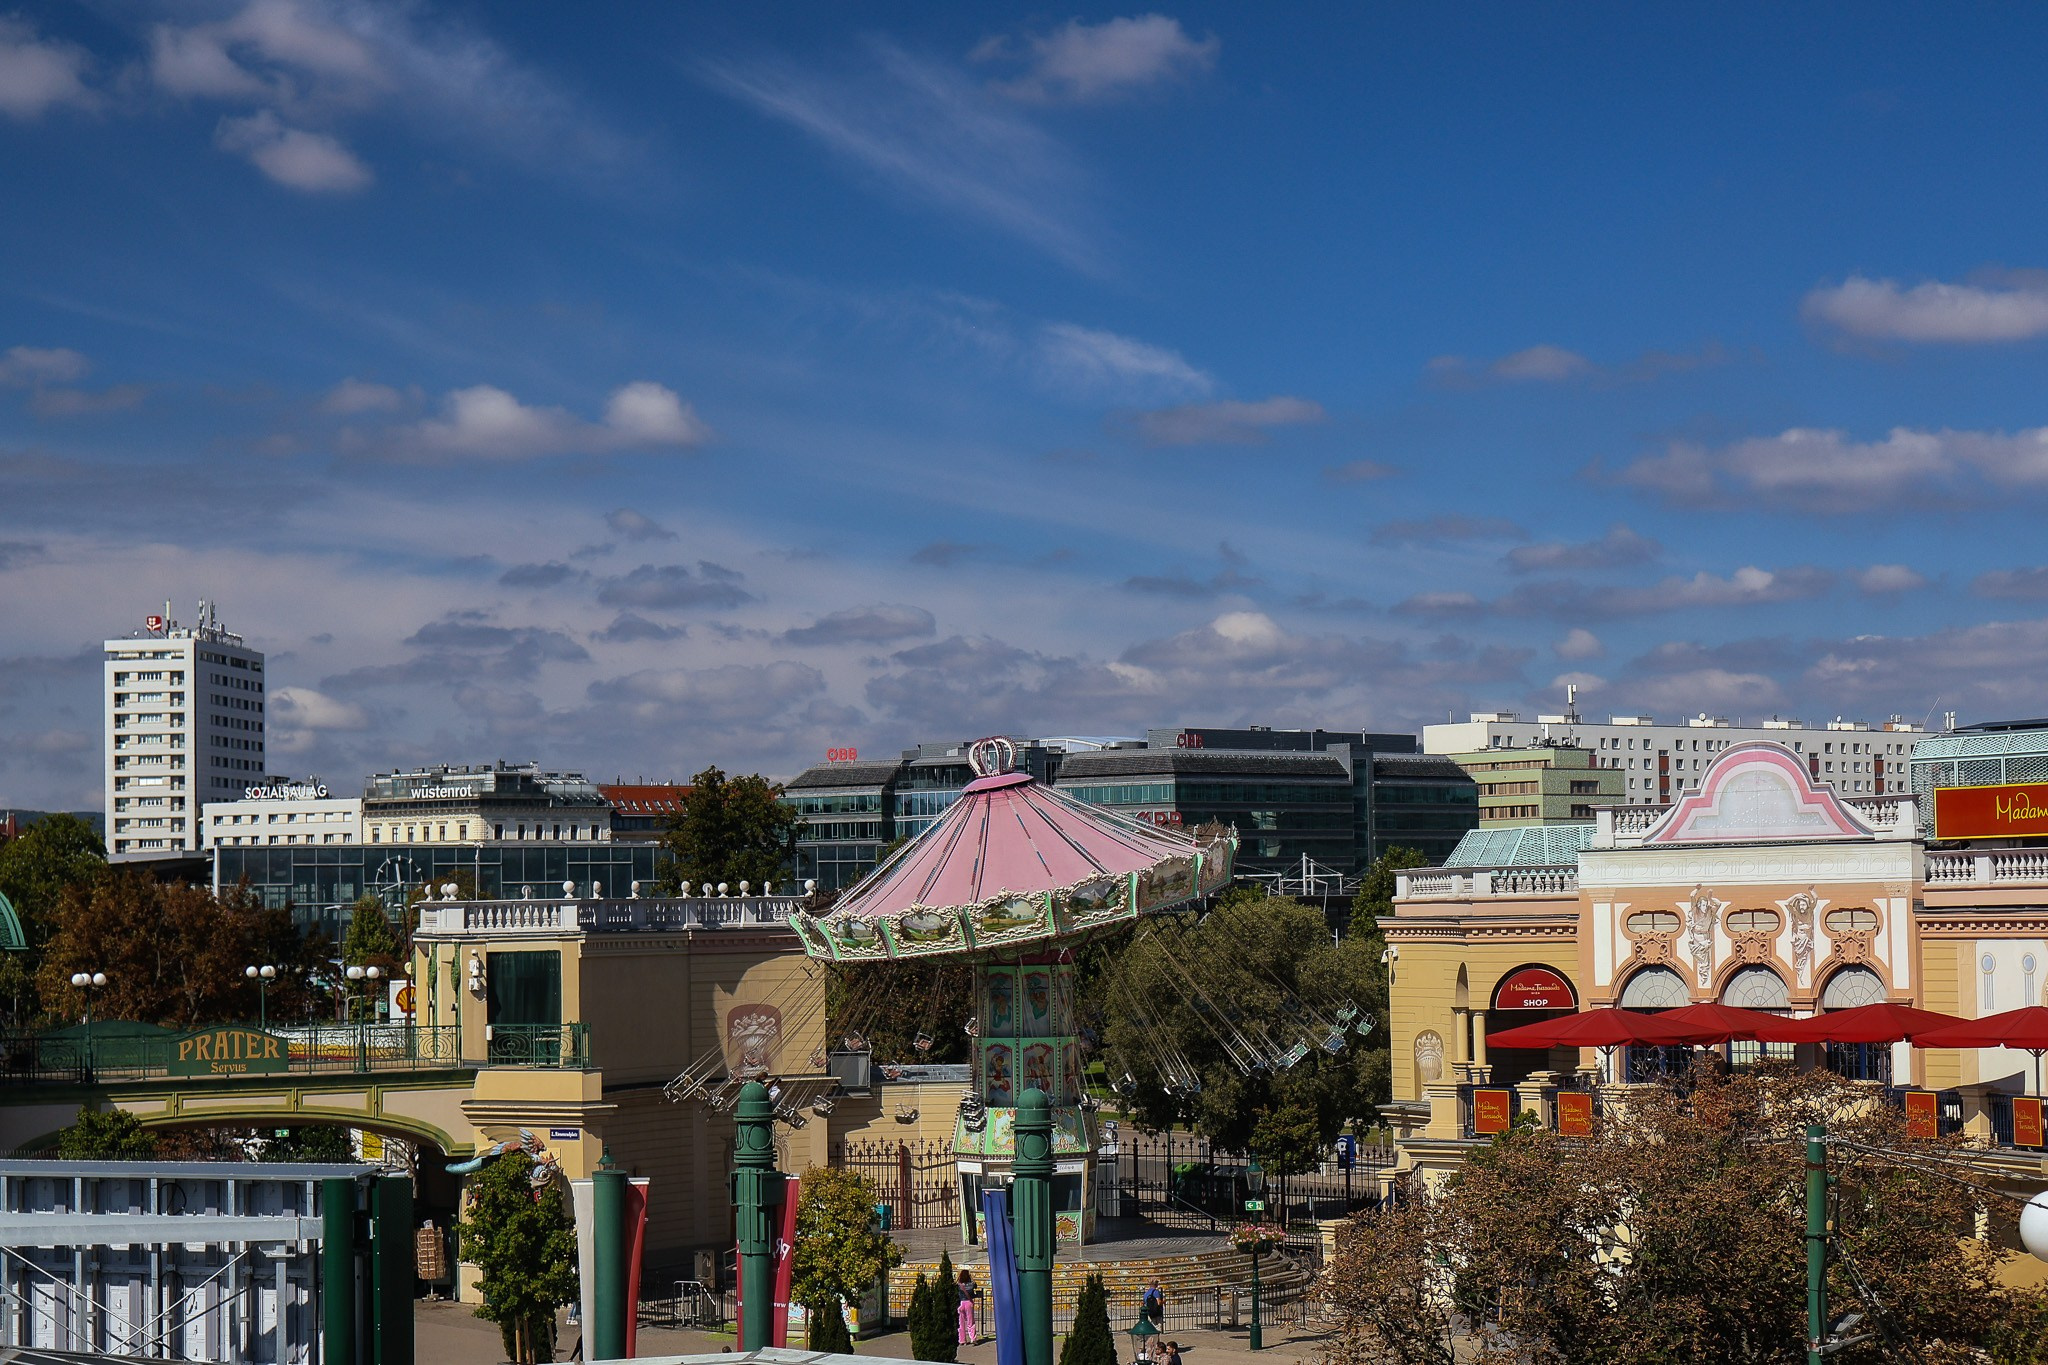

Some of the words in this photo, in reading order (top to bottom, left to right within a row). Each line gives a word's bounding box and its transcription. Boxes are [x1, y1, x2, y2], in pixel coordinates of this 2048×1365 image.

[245, 785, 306, 799] SOZIALBAU
[309, 784, 327, 798] AG
[1523, 999, 1548, 1007] SHOP
[178, 1031, 281, 1061] PRATER
[211, 1062, 248, 1073] Servus
